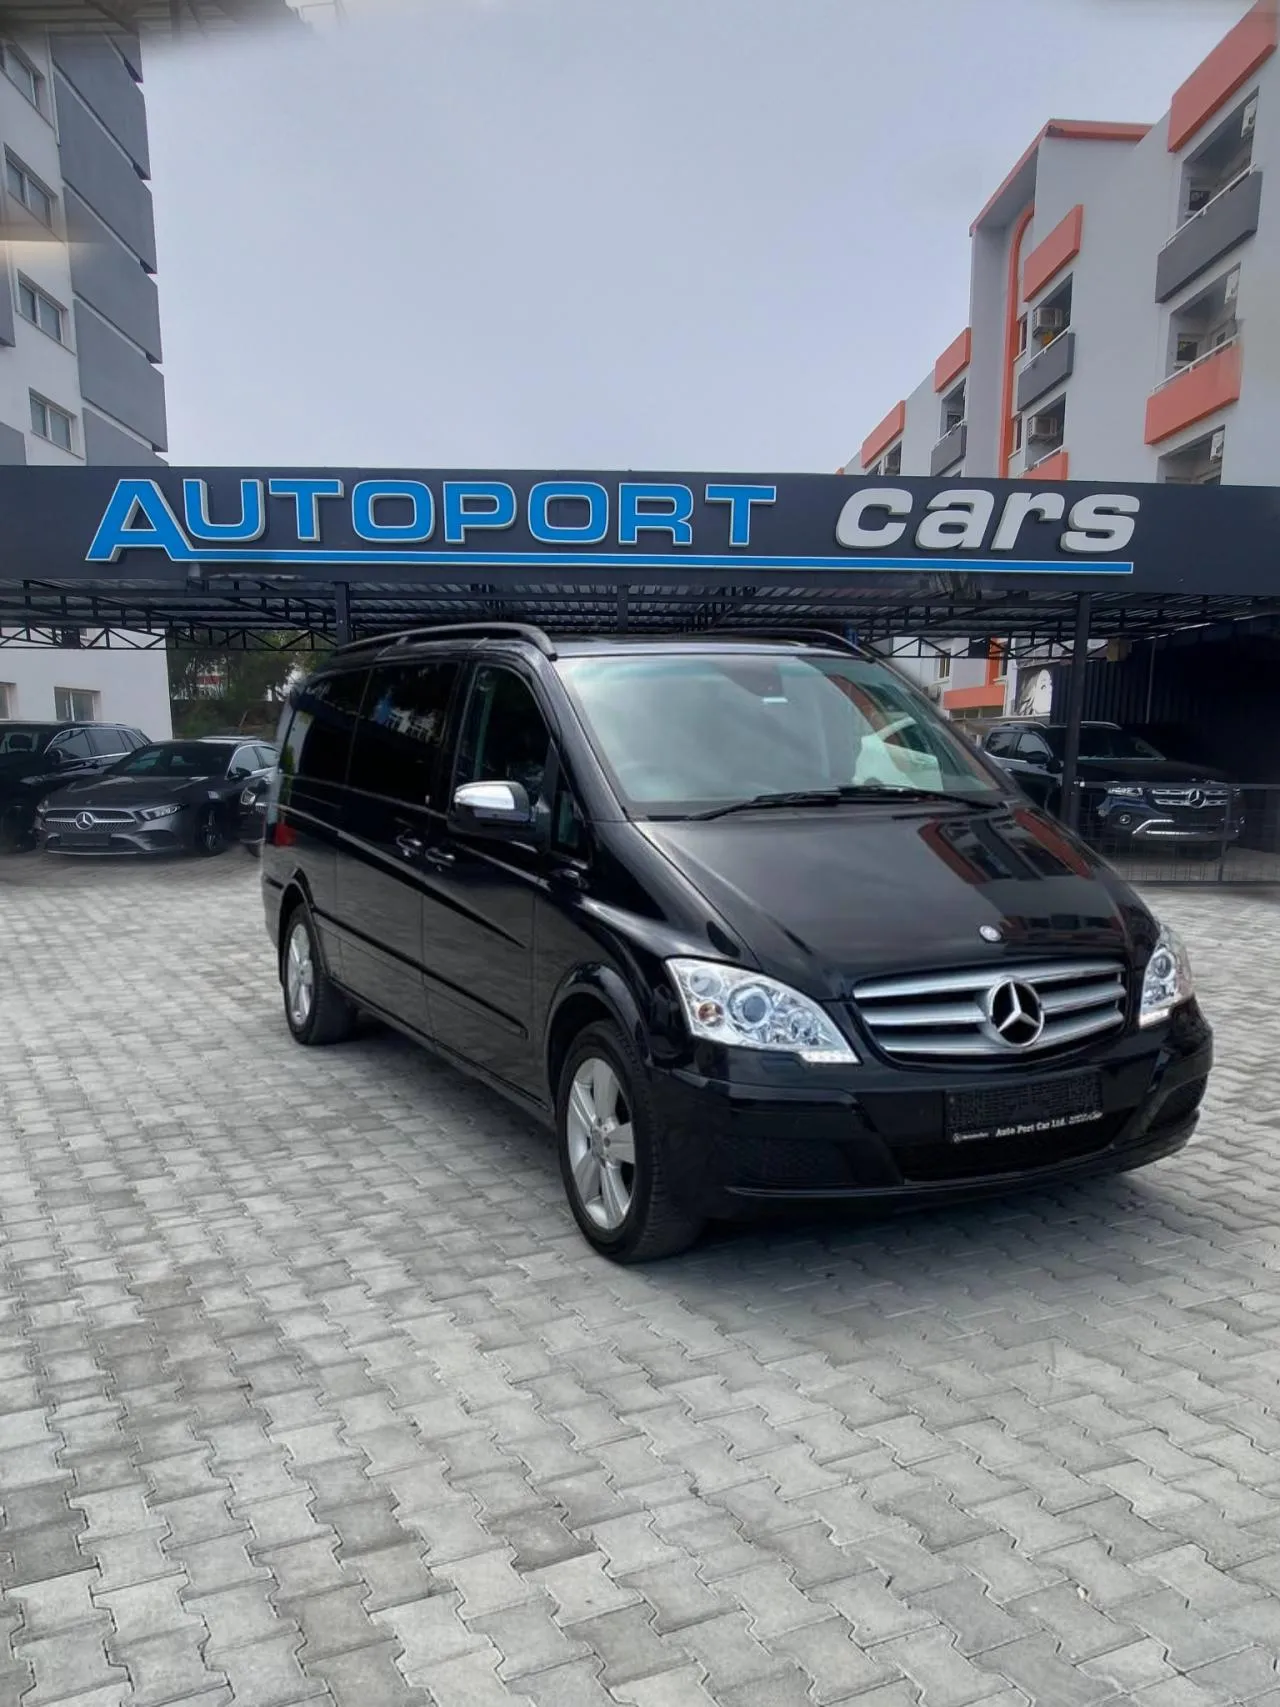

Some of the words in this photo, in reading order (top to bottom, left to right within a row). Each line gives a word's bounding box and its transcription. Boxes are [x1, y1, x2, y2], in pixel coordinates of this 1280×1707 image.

[84, 478, 778, 563] AUTOPORT
[835, 487, 1141, 554] cars
[995, 1126, 1015, 1137] Auto
[1017, 1124, 1034, 1135] Port
[1036, 1121, 1050, 1131] Car
